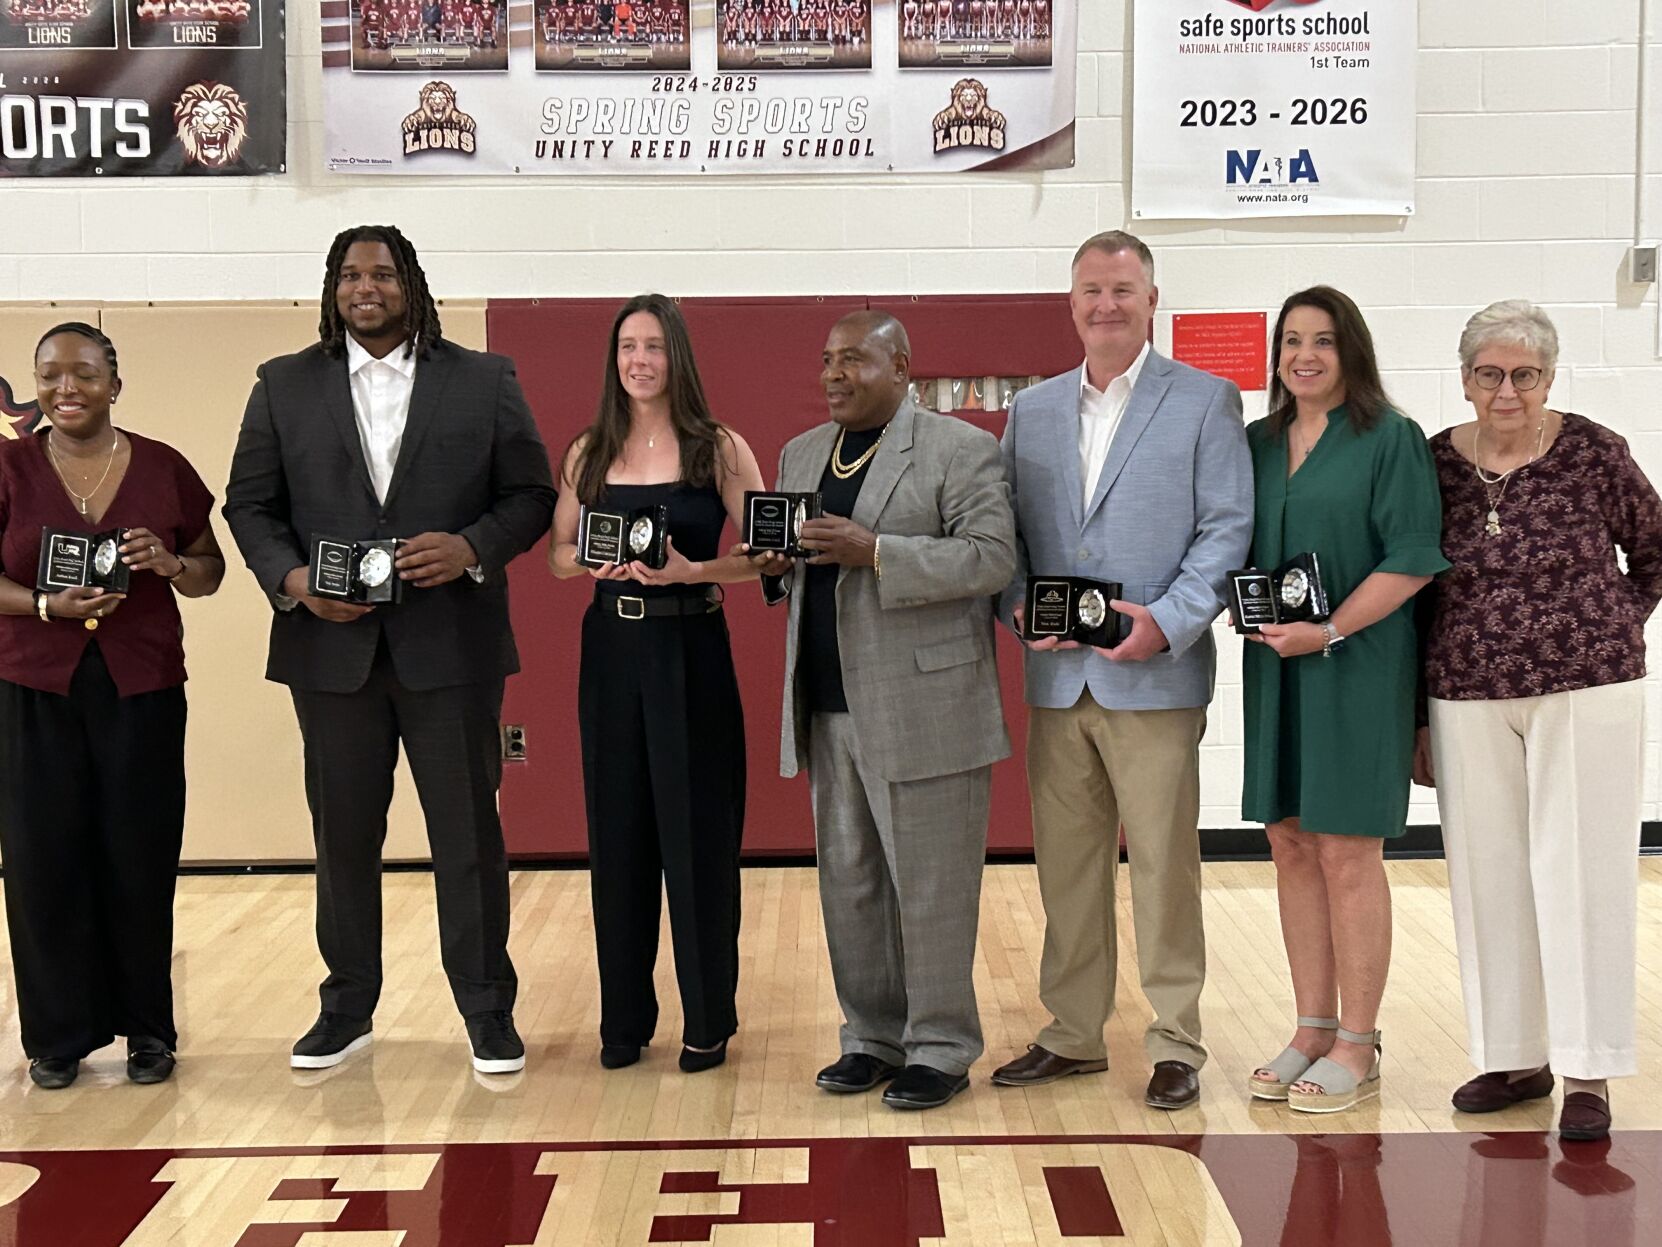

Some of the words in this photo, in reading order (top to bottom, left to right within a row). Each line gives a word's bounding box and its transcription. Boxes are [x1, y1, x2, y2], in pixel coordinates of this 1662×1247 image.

[28, 27, 71, 44] LIONS
[173, 26, 217, 43] LIONS
[1180, 13, 1224, 37] safe
[1230, 14, 1296, 42] sports
[1302, 11, 1370, 36] school
[1179, 43, 1221, 54] NATIONAL
[1223, 43, 1264, 54] ATHLETIC
[1313, 41, 1370, 52] ASSOCIATION
[1310, 56, 1329, 68] 1st
[1333, 55, 1370, 68] Team
[652, 76, 757, 92] 2024-2025
[540, 97, 691, 135] SPRING
[712, 96, 869, 135] SPORTS
[1180, 100, 1258, 127] 2023
[1290, 98, 1368, 125] 2026
[405, 128, 474, 154] LIONS
[935, 125, 1004, 151] LIONS
[535, 140, 614, 159] UNITY
[630, 140, 691, 159] REED
[708, 139, 766, 158] HIGH
[782, 138, 874, 157] SCHOOL
[1237, 194, 1309, 204] www.nata.org
